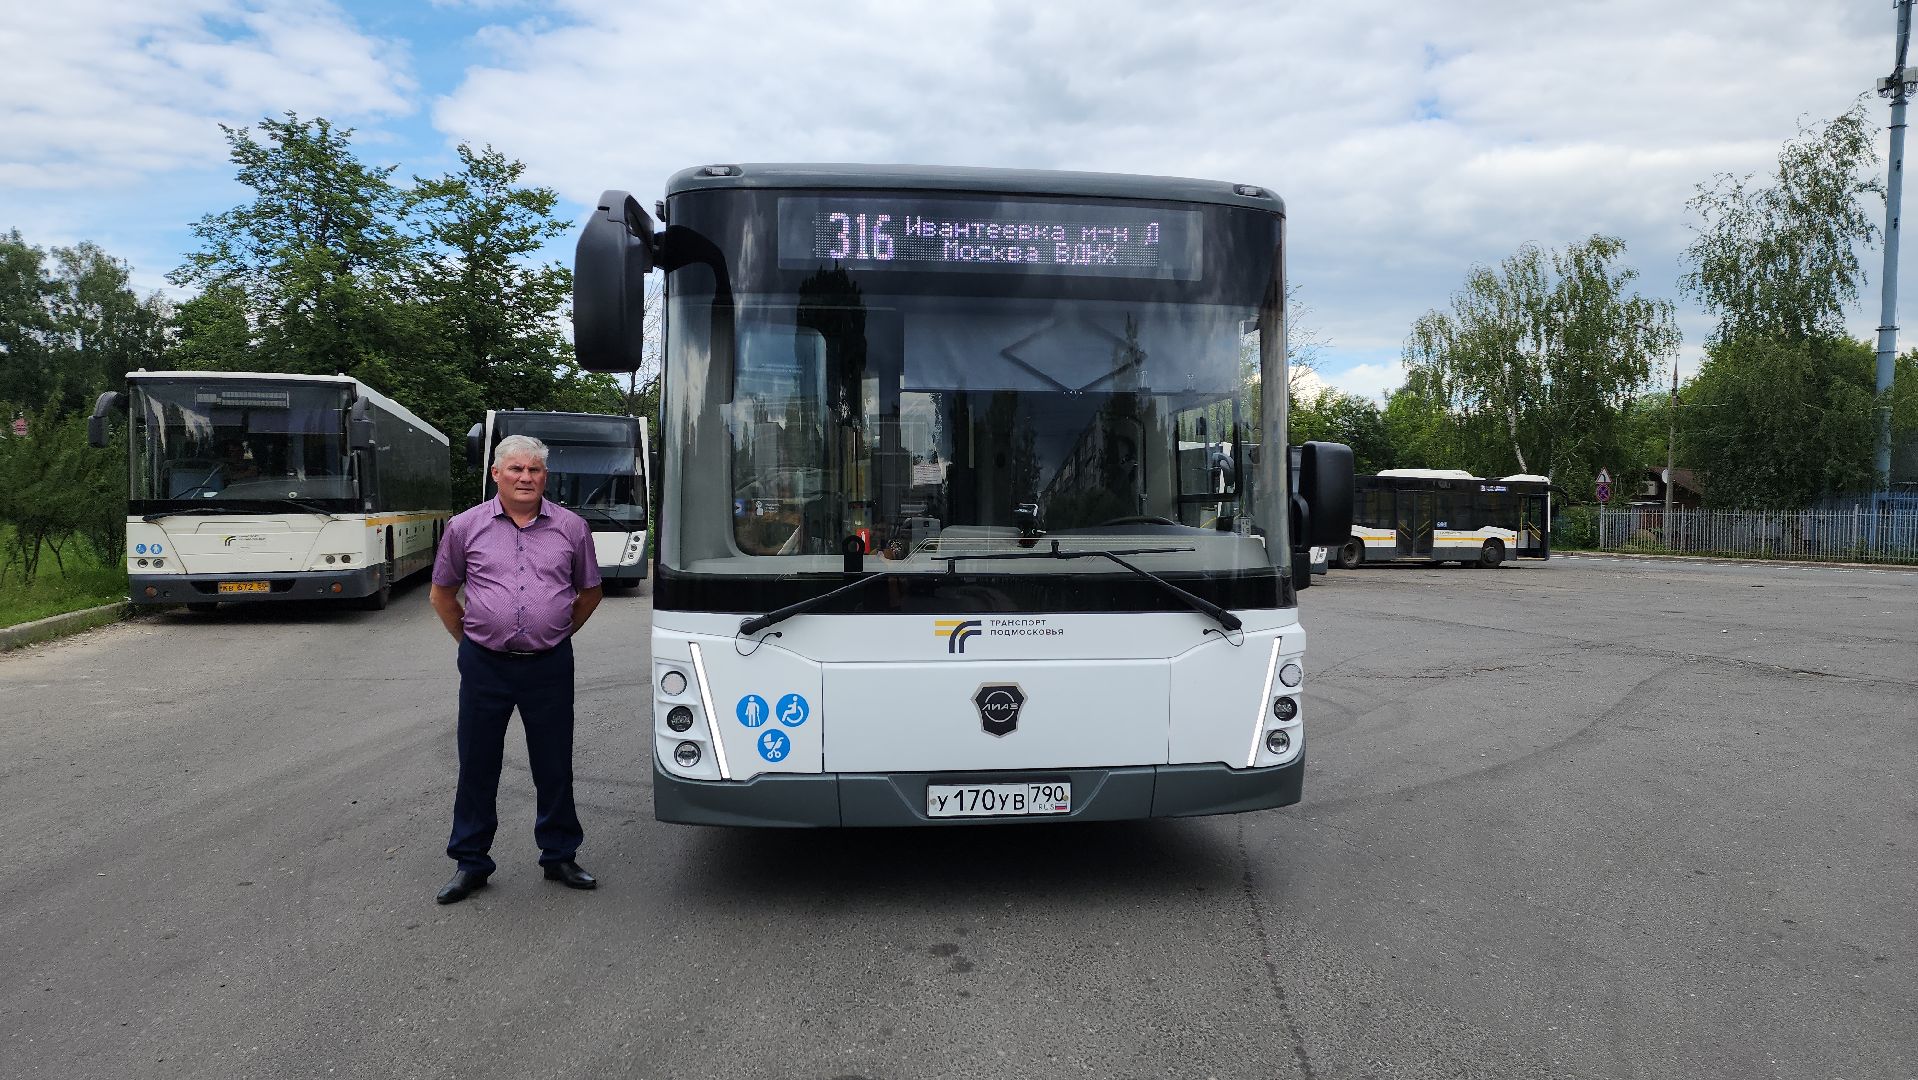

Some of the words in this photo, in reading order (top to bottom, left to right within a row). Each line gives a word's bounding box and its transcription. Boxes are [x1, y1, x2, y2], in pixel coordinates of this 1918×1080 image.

[829, 212, 893, 260] 316
[905, 215, 1065, 241] Ивантеевка
[1082, 226, 1129, 242] м-н
[1145, 222, 1159, 245] Д
[944, 239, 1038, 262] Москва
[1055, 242, 1117, 265] ВДНХ
[990, 628, 1064, 636] ПОДМОСКОВЬЯ
[937, 789, 1025, 811] У170УВ
[1031, 785, 1065, 803] 790
